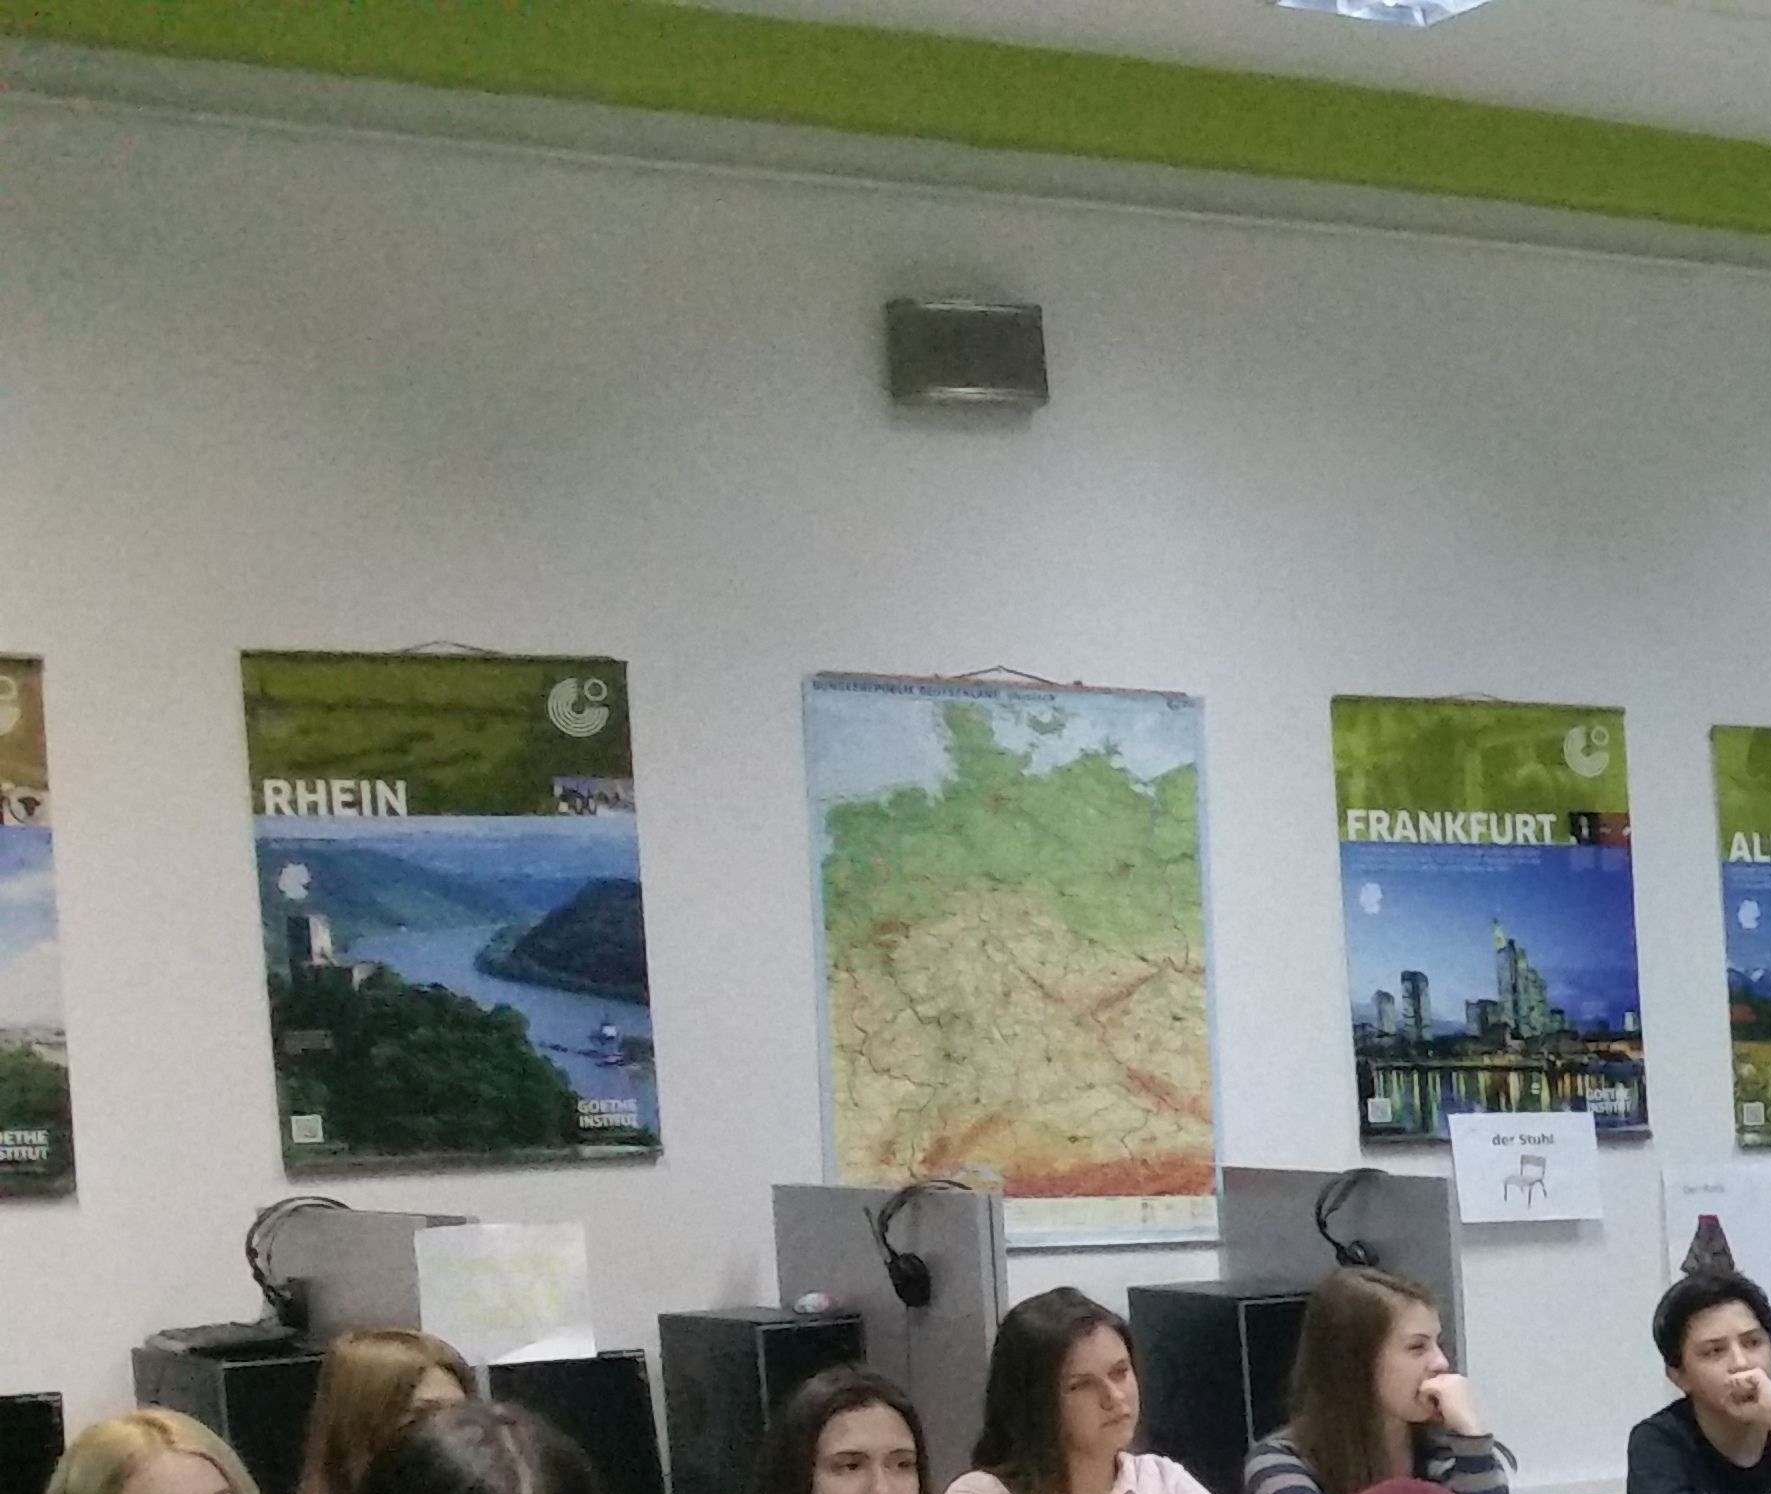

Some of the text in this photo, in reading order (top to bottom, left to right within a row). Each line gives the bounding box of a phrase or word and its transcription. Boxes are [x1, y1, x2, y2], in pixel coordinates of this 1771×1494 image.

[263, 778, 408, 817] RHEIN
[1345, 808, 1558, 845] FRANKFURT
[577, 1099, 638, 1113] GOETHE
[1491, 1133, 1554, 1146] der Stuhl
